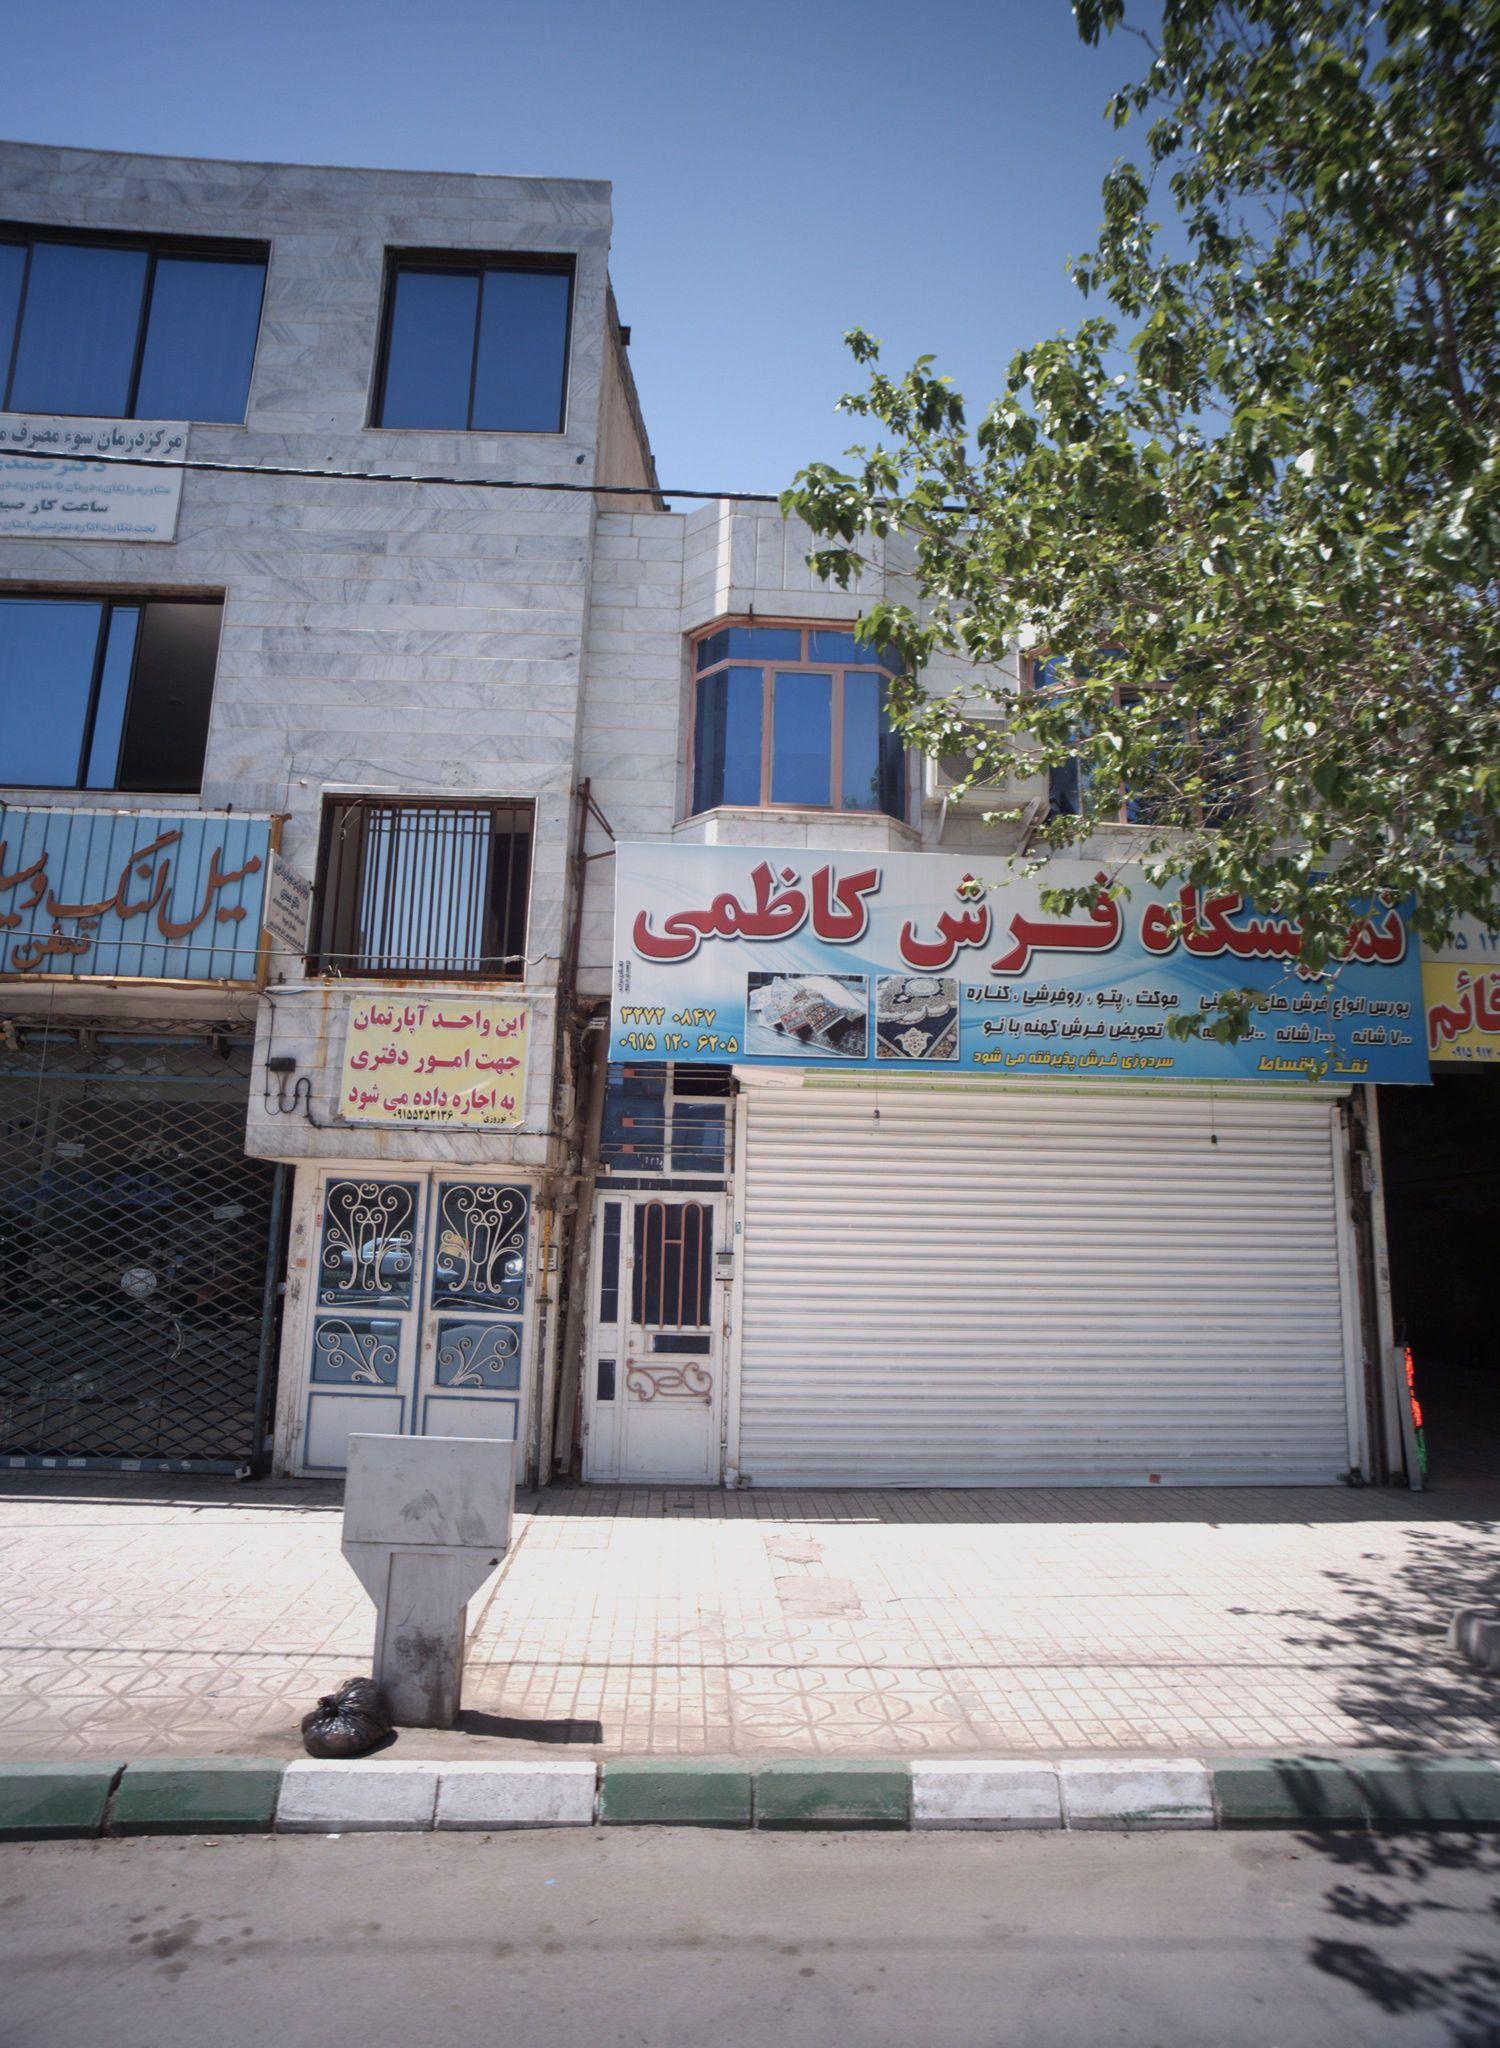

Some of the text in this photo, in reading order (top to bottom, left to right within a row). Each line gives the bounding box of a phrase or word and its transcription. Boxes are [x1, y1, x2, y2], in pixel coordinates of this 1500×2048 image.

[11, 422, 60, 449] مصرف
[64, 432, 94, 451] سوء
[96, 427, 145, 452] درمان
[29, 497, 58, 514] کار
[62, 500, 108, 513] ساعت
[157, 846, 262, 939] میل
[632, 860, 878, 960] کاظمی
[898, 870, 1124, 973] فرش
[1140, 881, 1406, 981] نمیشگاه
[966, 984, 1011, 1003] کناره
[1022, 984, 1082, 1008] روفرشی
[1096, 988, 1123, 1013] پتو
[1135, 988, 1179, 1008] موکت
[1292, 992, 1328, 1014] فرش
[619, 1006, 716, 1027] ۳۲۷۲ ۰۸۴۷
[1332, 998, 1365, 1019] انواع
[1368, 1000, 1409, 1018] بورس
[353, 1004, 526, 1038] این واحد آپارتمان
[983, 1017, 1164, 1041] تعویض فرش کهنه با نو
[1276, 1023, 1309, 1042] شانه
[619, 1031, 739, 1054] ۰۹۱۵ ۱۲۰ ۶۲۰۵
[1352, 1026, 1386, 1044] شانه
[350, 1043, 521, 1077] جهت امور دفتری
[972, 1047, 1175, 1073] سردوزی فرش پذیرفته می شود
[1257, 1055, 1315, 1072] اقساط
[1333, 1057, 1369, 1074] نقد
[348, 1083, 516, 1117] به اجاره داده می شود
